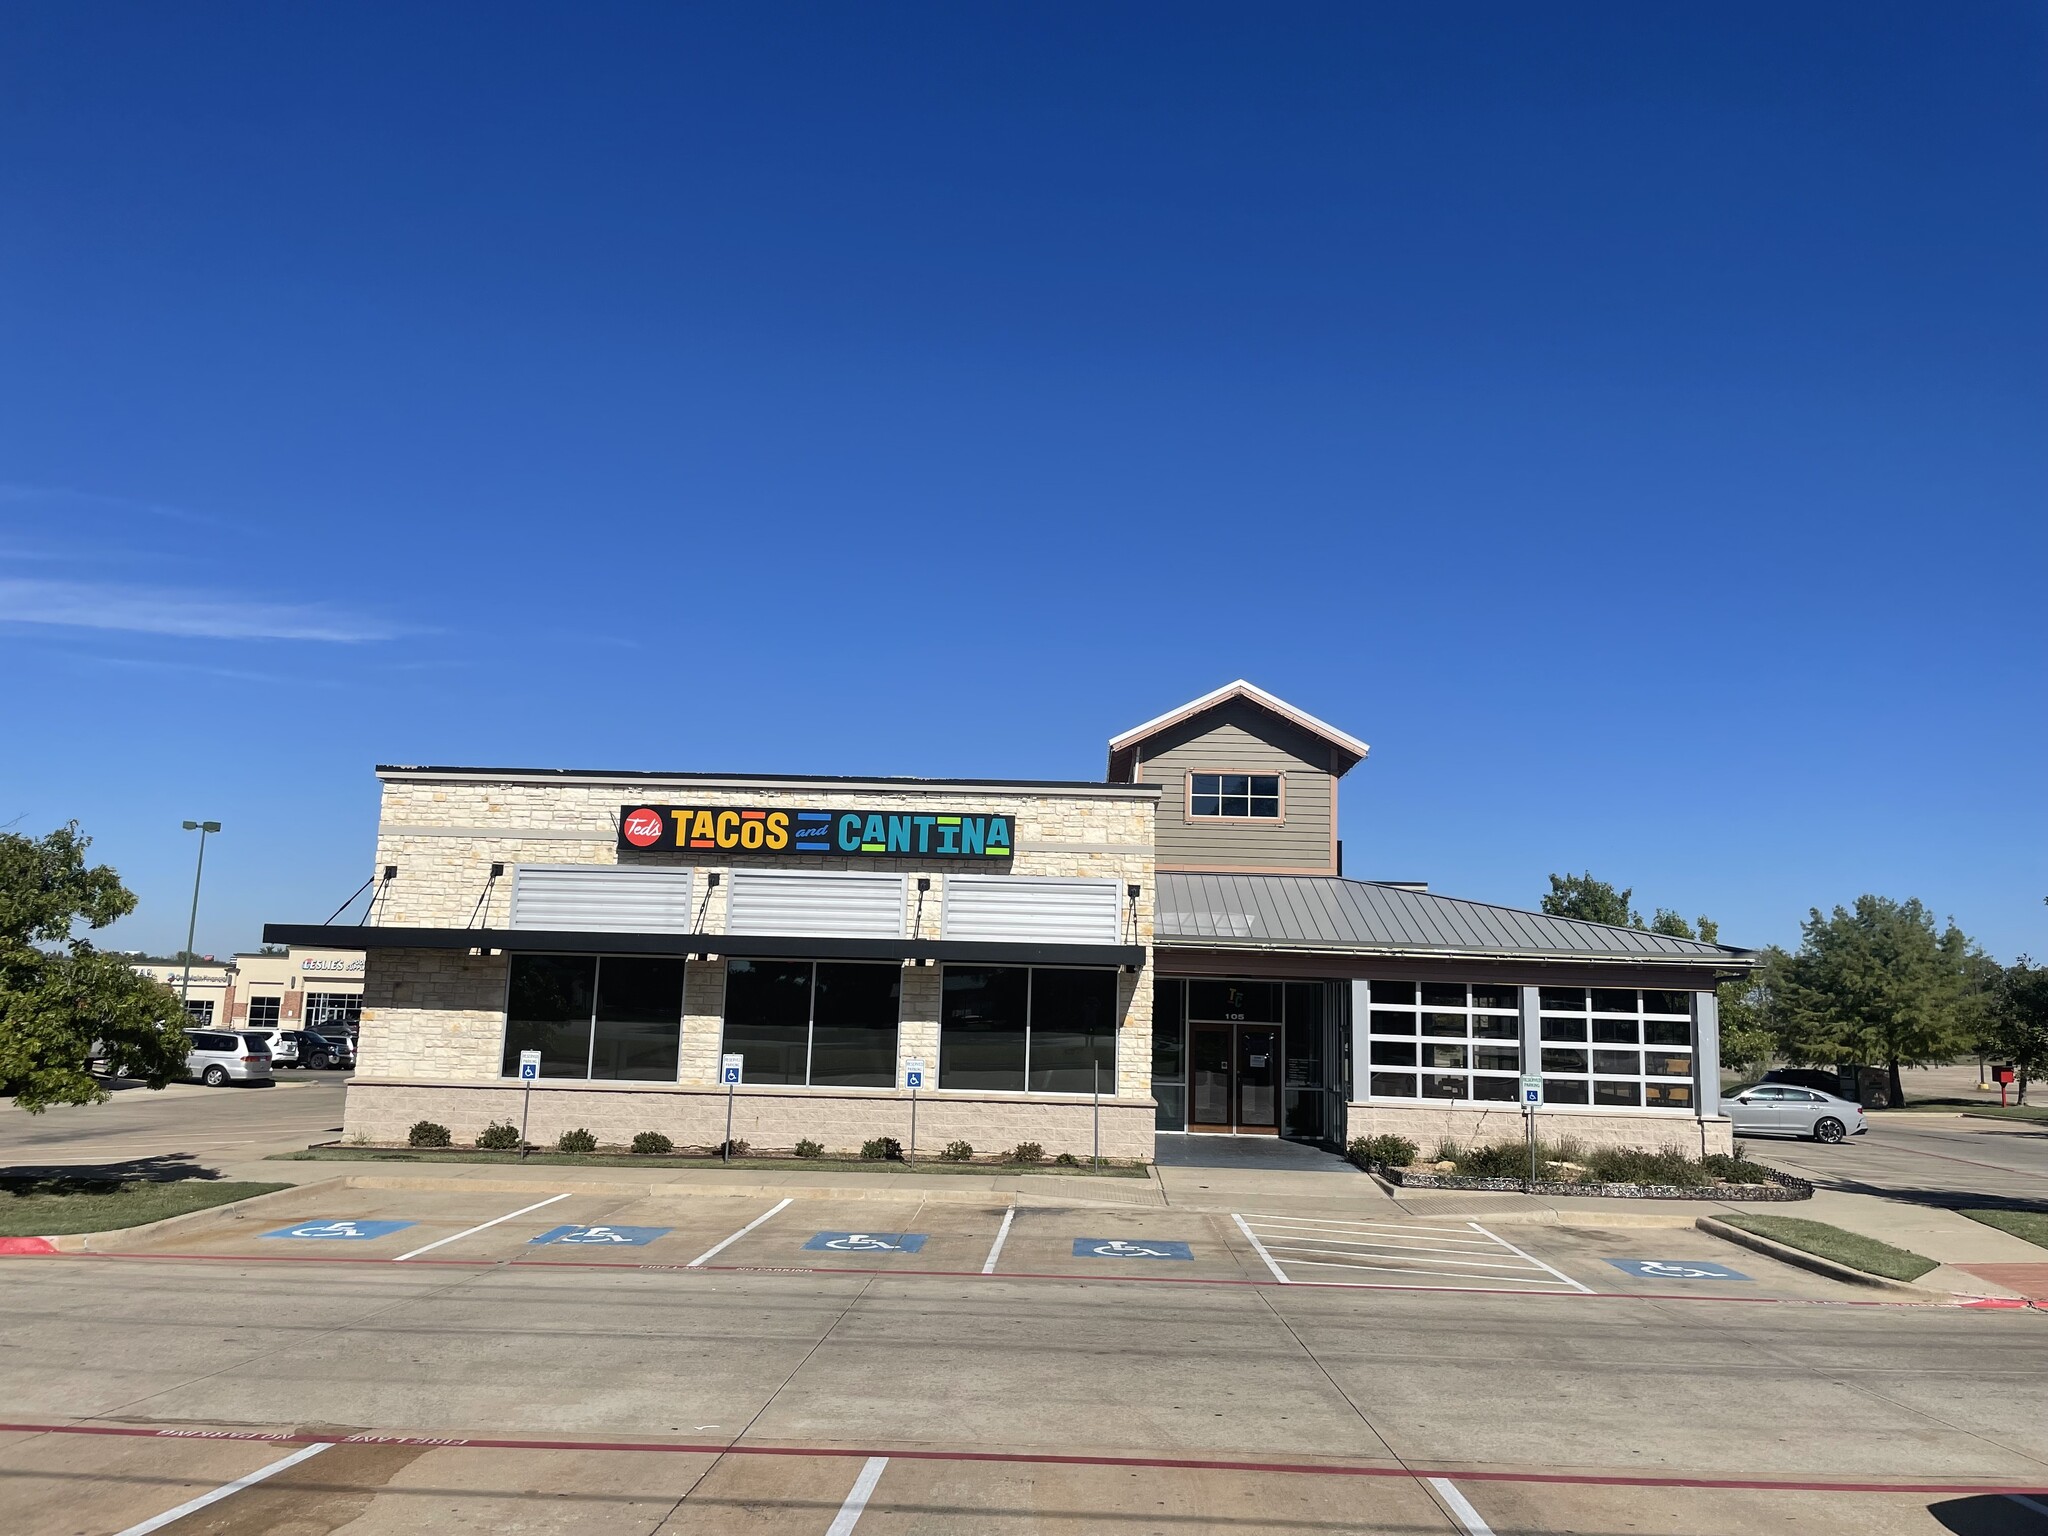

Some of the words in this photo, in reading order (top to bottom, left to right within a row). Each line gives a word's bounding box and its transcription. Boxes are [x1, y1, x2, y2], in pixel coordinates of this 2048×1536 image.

[626, 818, 662, 837] Ted's
[671, 810, 789, 849] TACOS
[795, 824, 829, 838] and
[838, 813, 1010, 855] CANTINA
[302, 958, 345, 971] LESLIE'S
